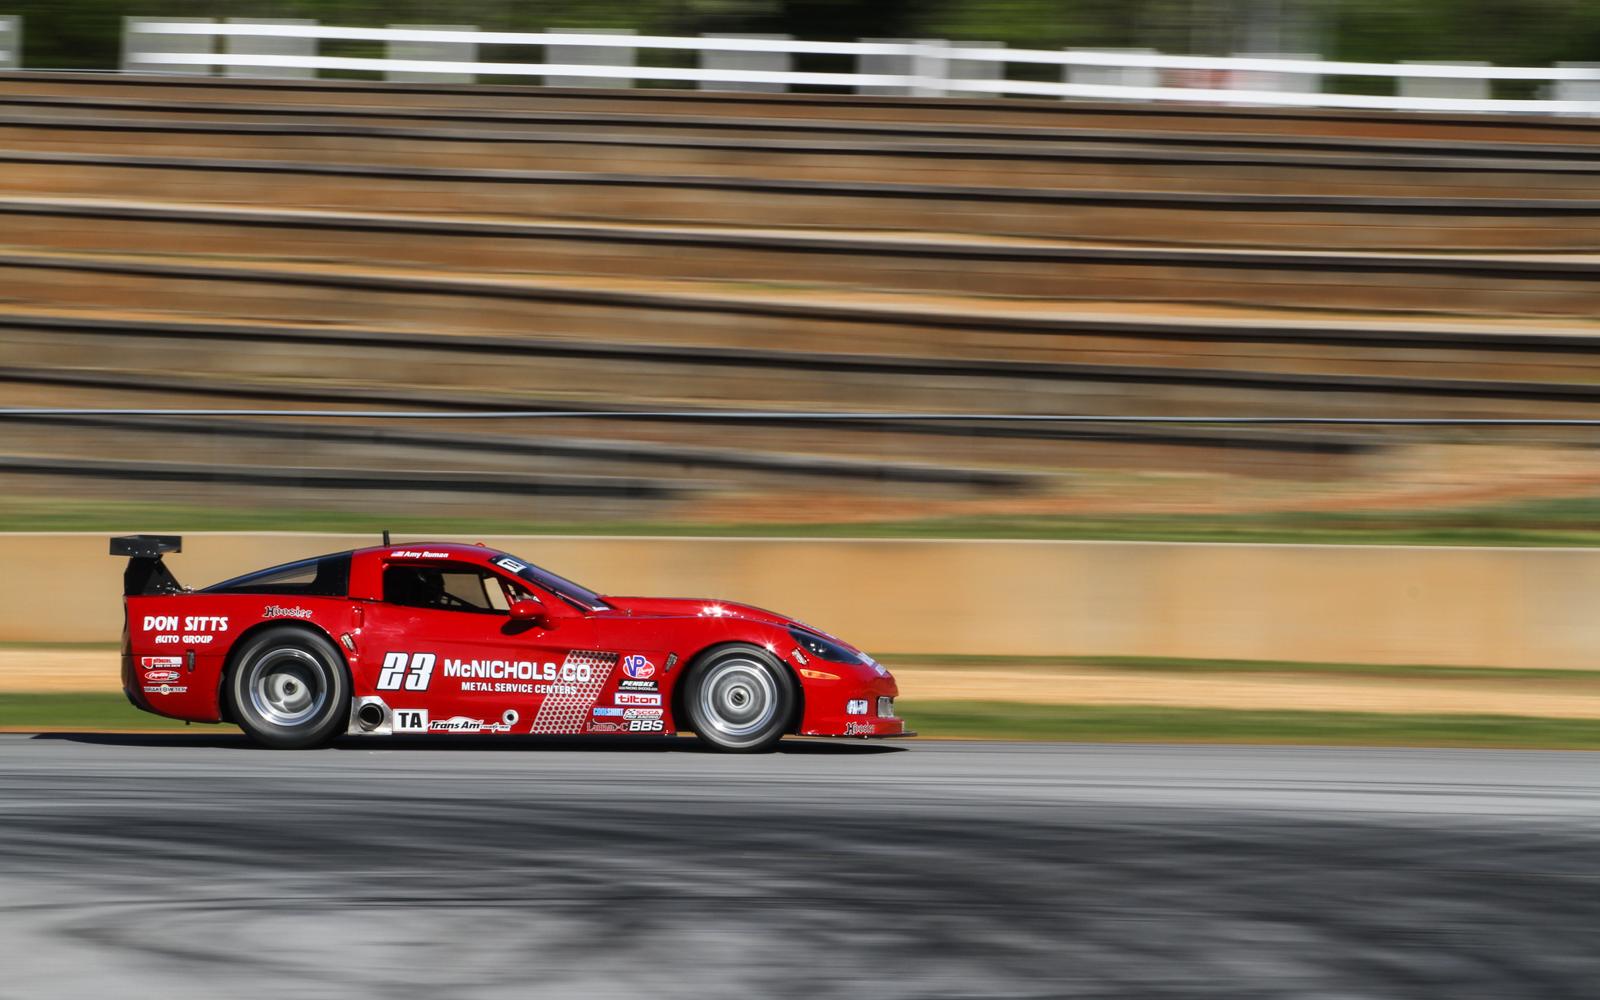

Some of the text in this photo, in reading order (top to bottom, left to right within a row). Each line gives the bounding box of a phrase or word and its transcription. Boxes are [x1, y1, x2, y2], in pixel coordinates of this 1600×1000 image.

[143, 616, 228, 631] DON SITTS
[155, 636, 179, 644] AUTO
[376, 652, 436, 691] 23
[444, 659, 556, 680] McNICHOLS
[625, 656, 646, 677] VP
[462, 682, 576, 694] METAL SERVICE CENTERS
[618, 695, 658, 704] tilton
[398, 712, 422, 728] TA
[630, 720, 664, 731] BBS
